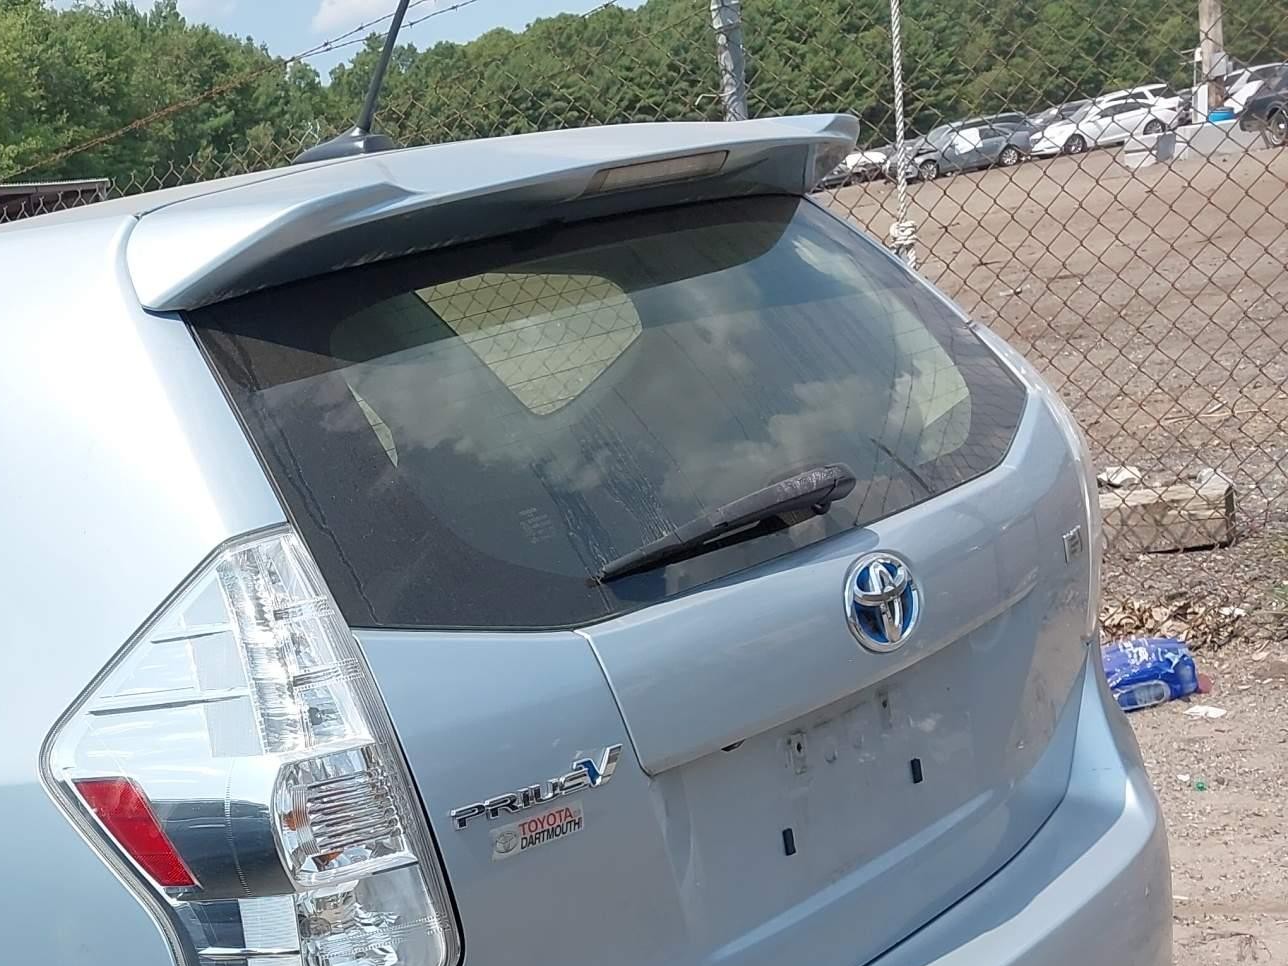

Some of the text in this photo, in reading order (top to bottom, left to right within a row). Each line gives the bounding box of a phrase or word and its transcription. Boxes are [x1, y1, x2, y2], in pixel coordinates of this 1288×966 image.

[449, 767, 589, 832] PRIUS
[519, 807, 574, 836] TOYOTA
[520, 816, 583, 850] DARTMOUTH
